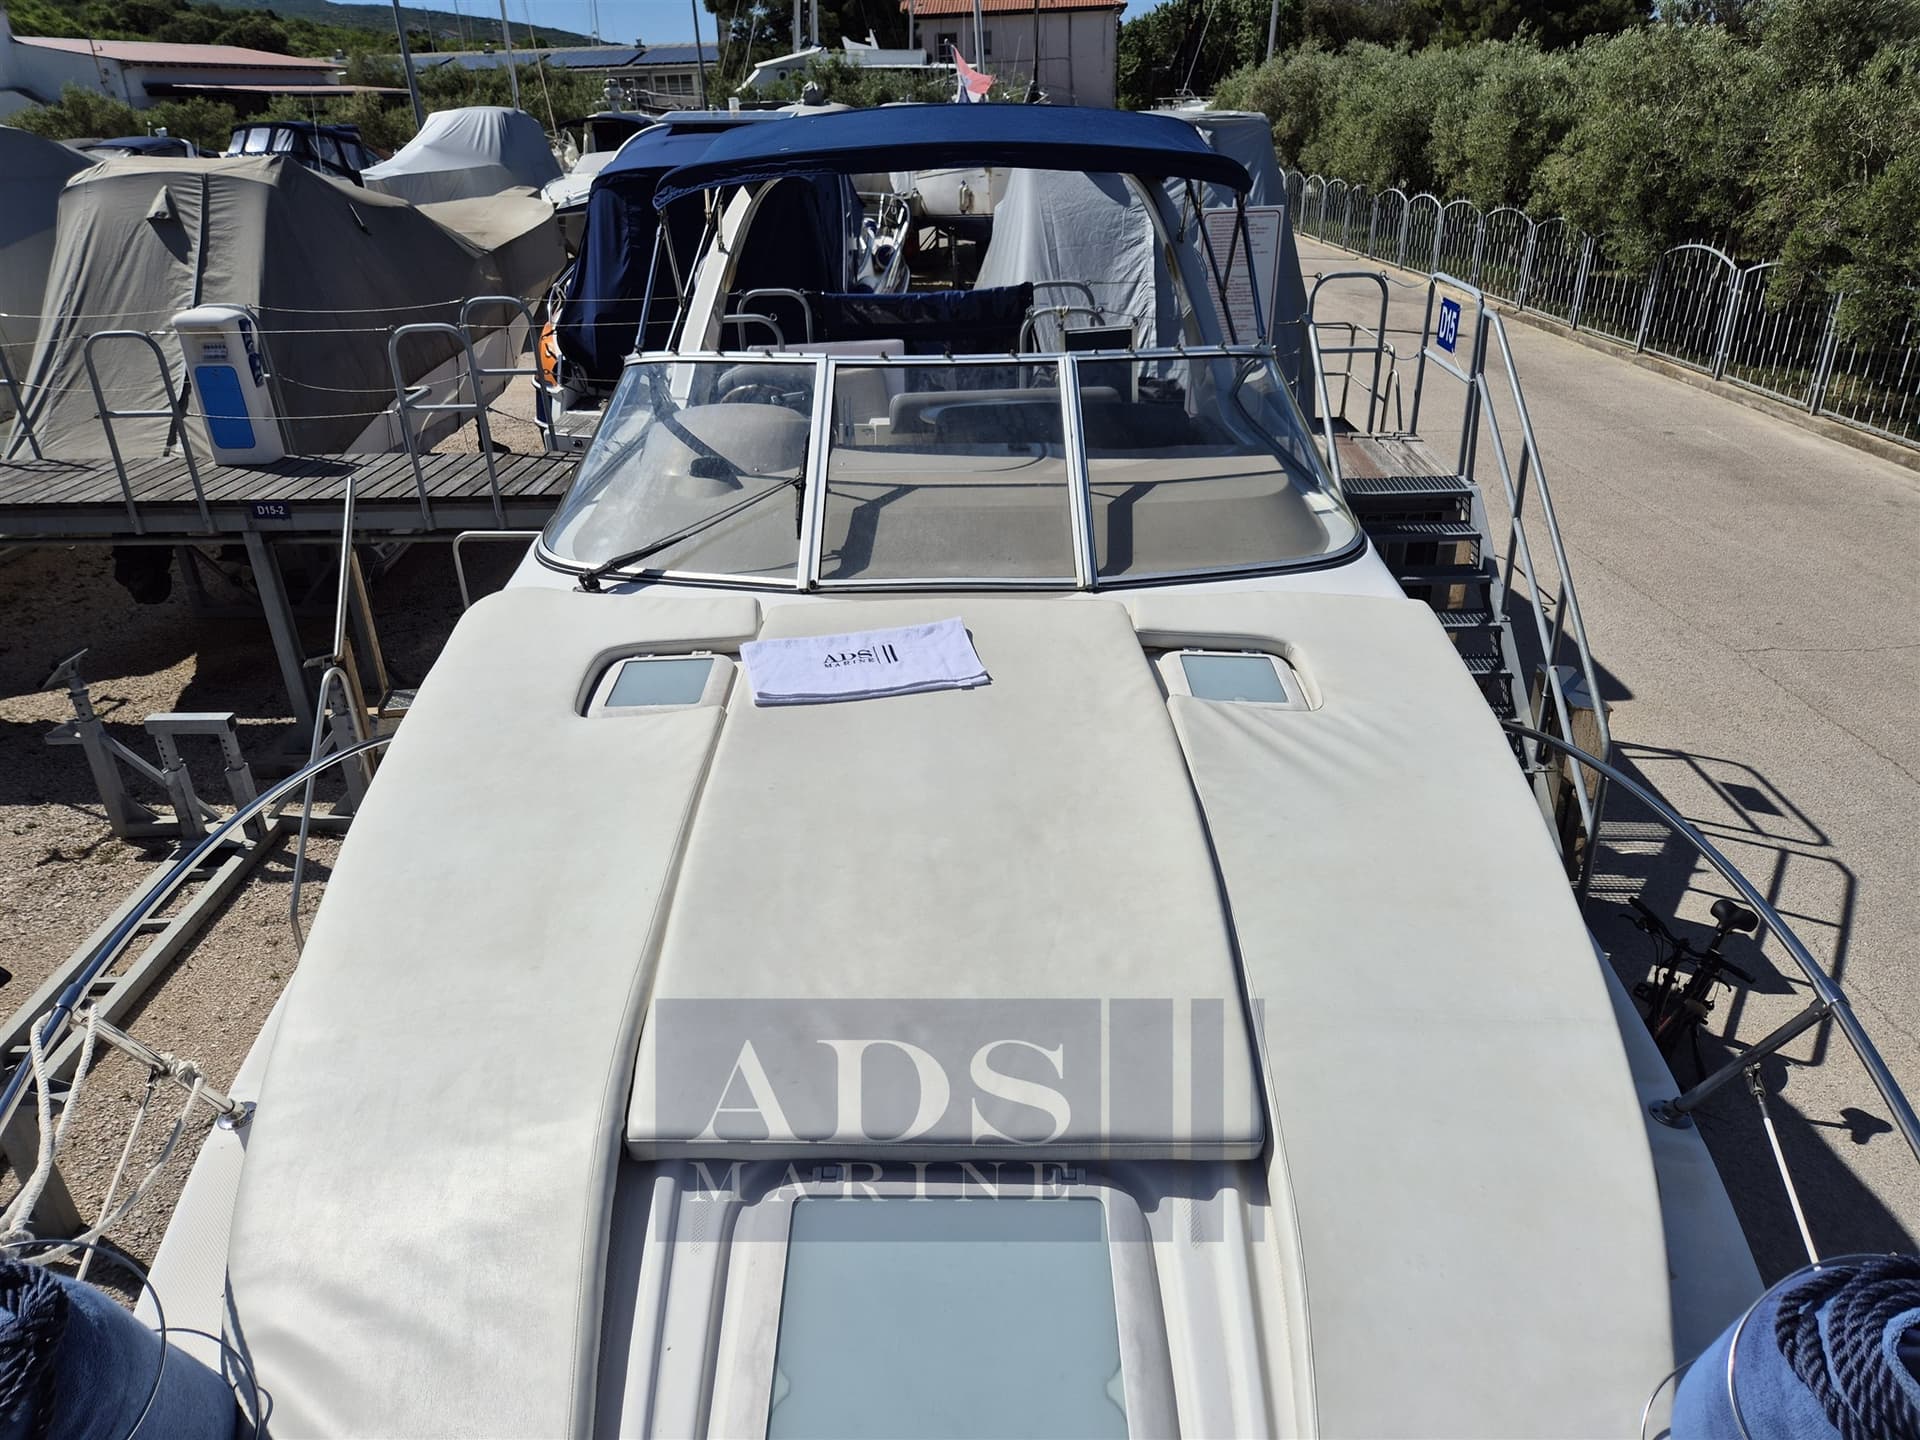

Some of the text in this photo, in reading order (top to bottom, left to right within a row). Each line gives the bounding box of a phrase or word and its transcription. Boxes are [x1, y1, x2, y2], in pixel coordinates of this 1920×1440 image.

[1439, 305, 1457, 344] D15
[256, 505, 285, 515] D15-2
[824, 649, 873, 664] ADS
